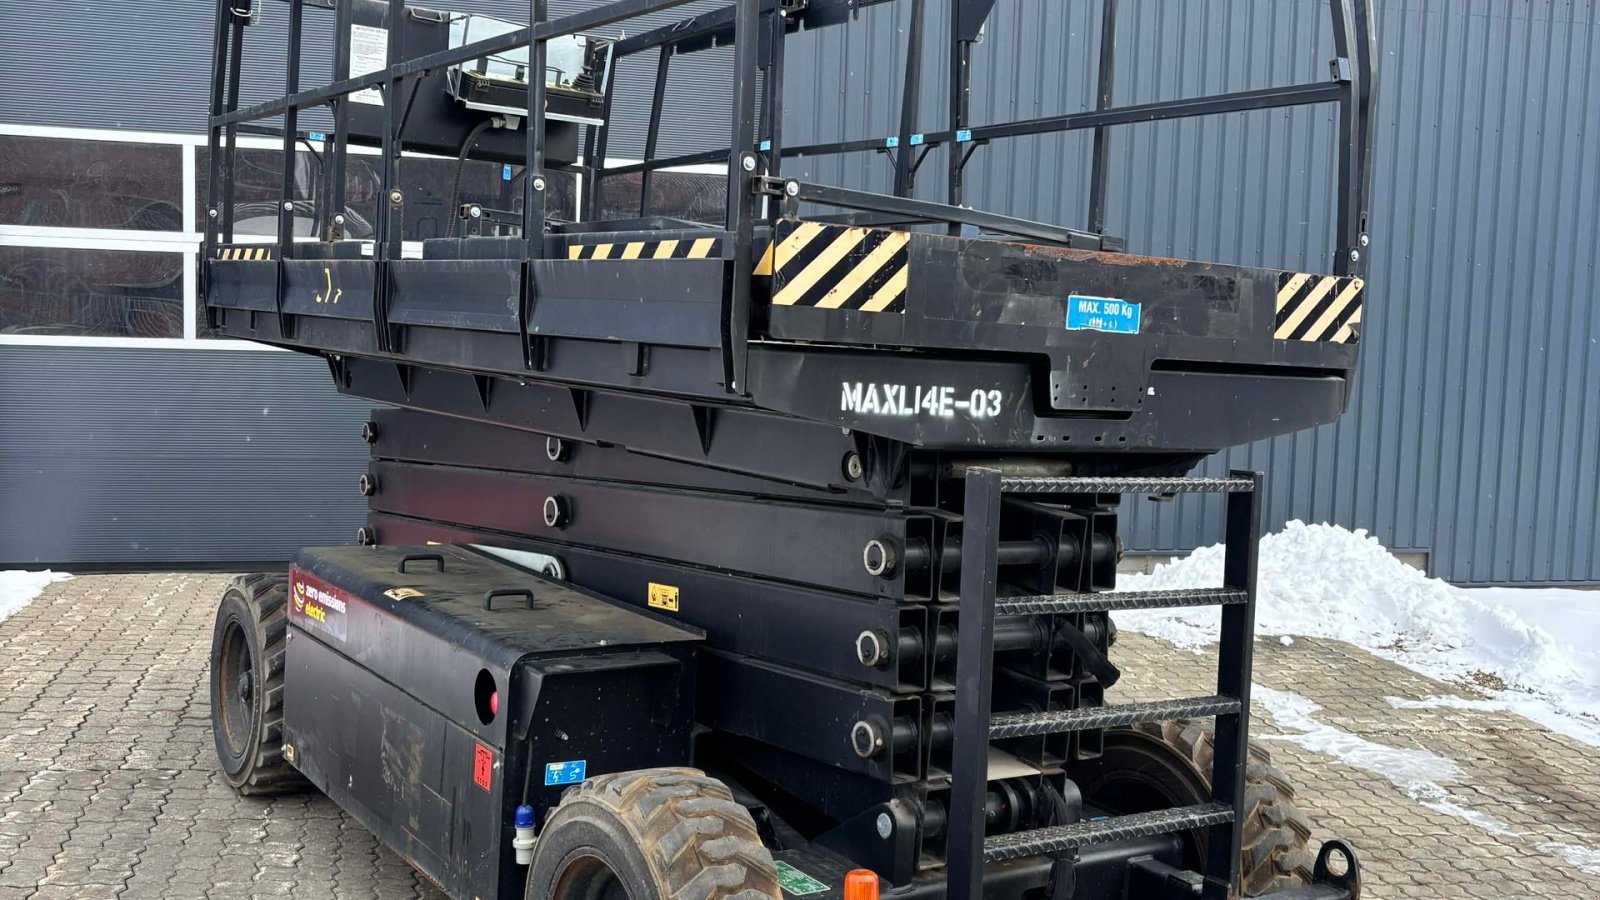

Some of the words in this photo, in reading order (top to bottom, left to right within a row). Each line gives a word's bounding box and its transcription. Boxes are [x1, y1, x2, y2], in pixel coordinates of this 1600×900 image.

[1078, 300, 1101, 314] MAX.
[1103, 302, 1119, 315] 500
[1121, 303, 1133, 319] Kg
[305, 585, 318, 600] zero
[319, 591, 346, 613] emissions
[305, 602, 325, 623] electric
